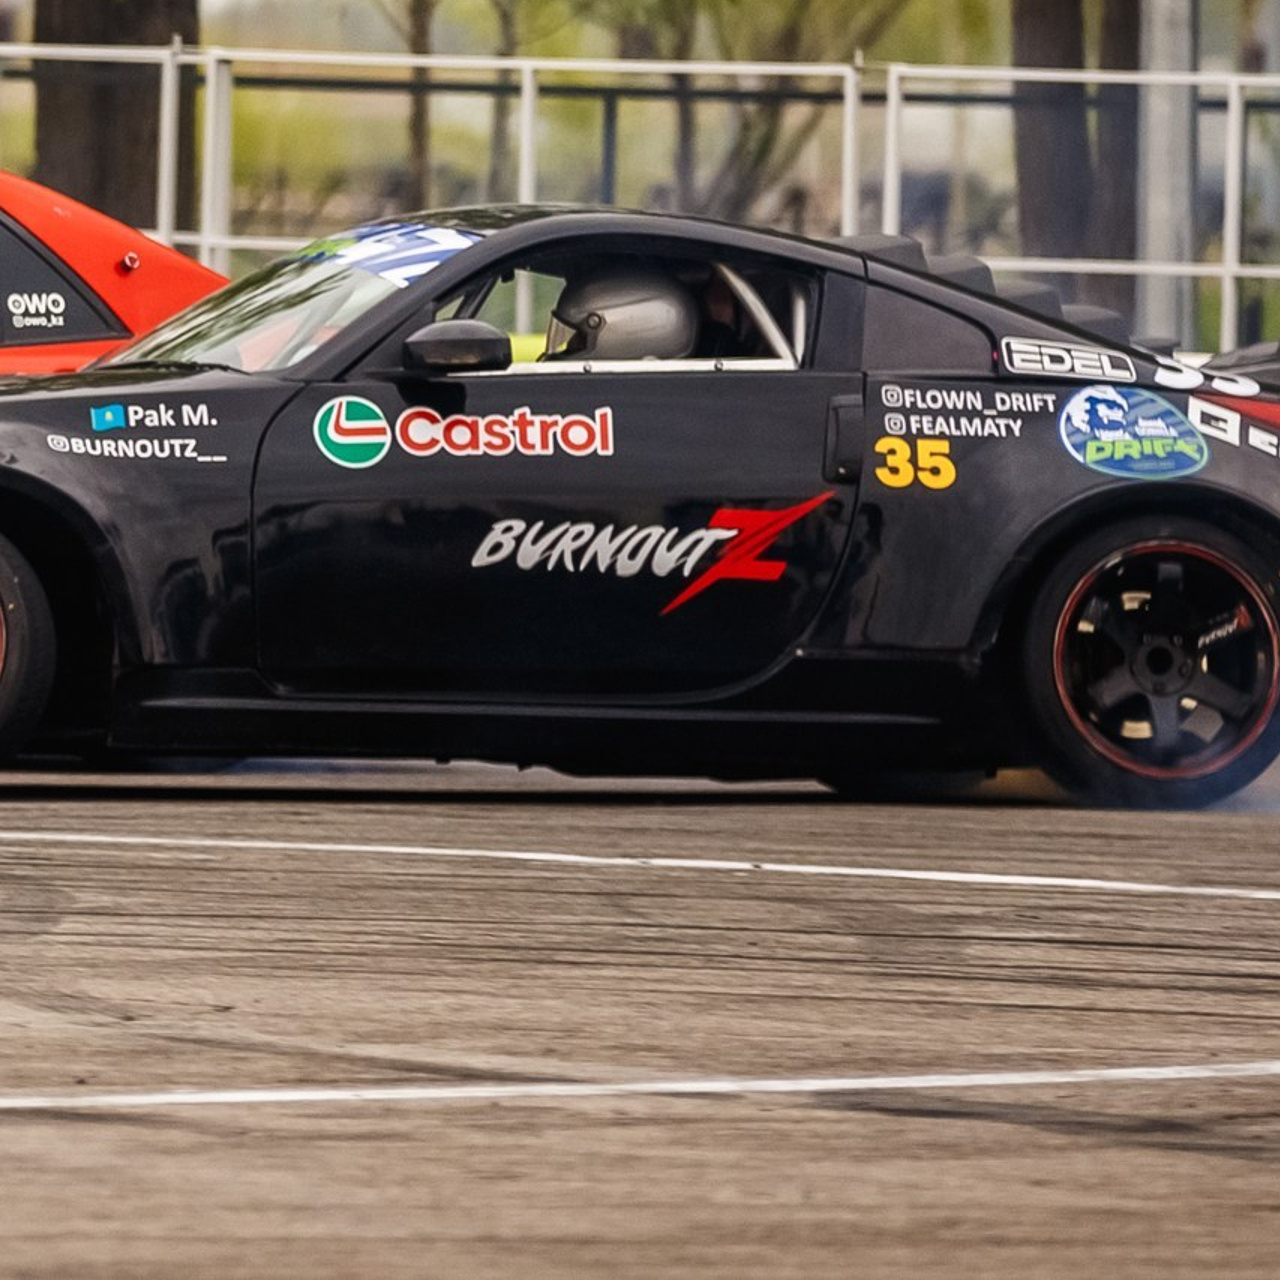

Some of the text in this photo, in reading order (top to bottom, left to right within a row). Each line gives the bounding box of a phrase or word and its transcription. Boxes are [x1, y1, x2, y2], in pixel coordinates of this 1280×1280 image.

[7, 292, 66, 315] OWO
[127, 403, 218, 427] Pak M.
[910, 415, 1022, 438] FEALMATY
[395, 406, 614, 457] Castrol
[874, 436, 957, 490] 35
